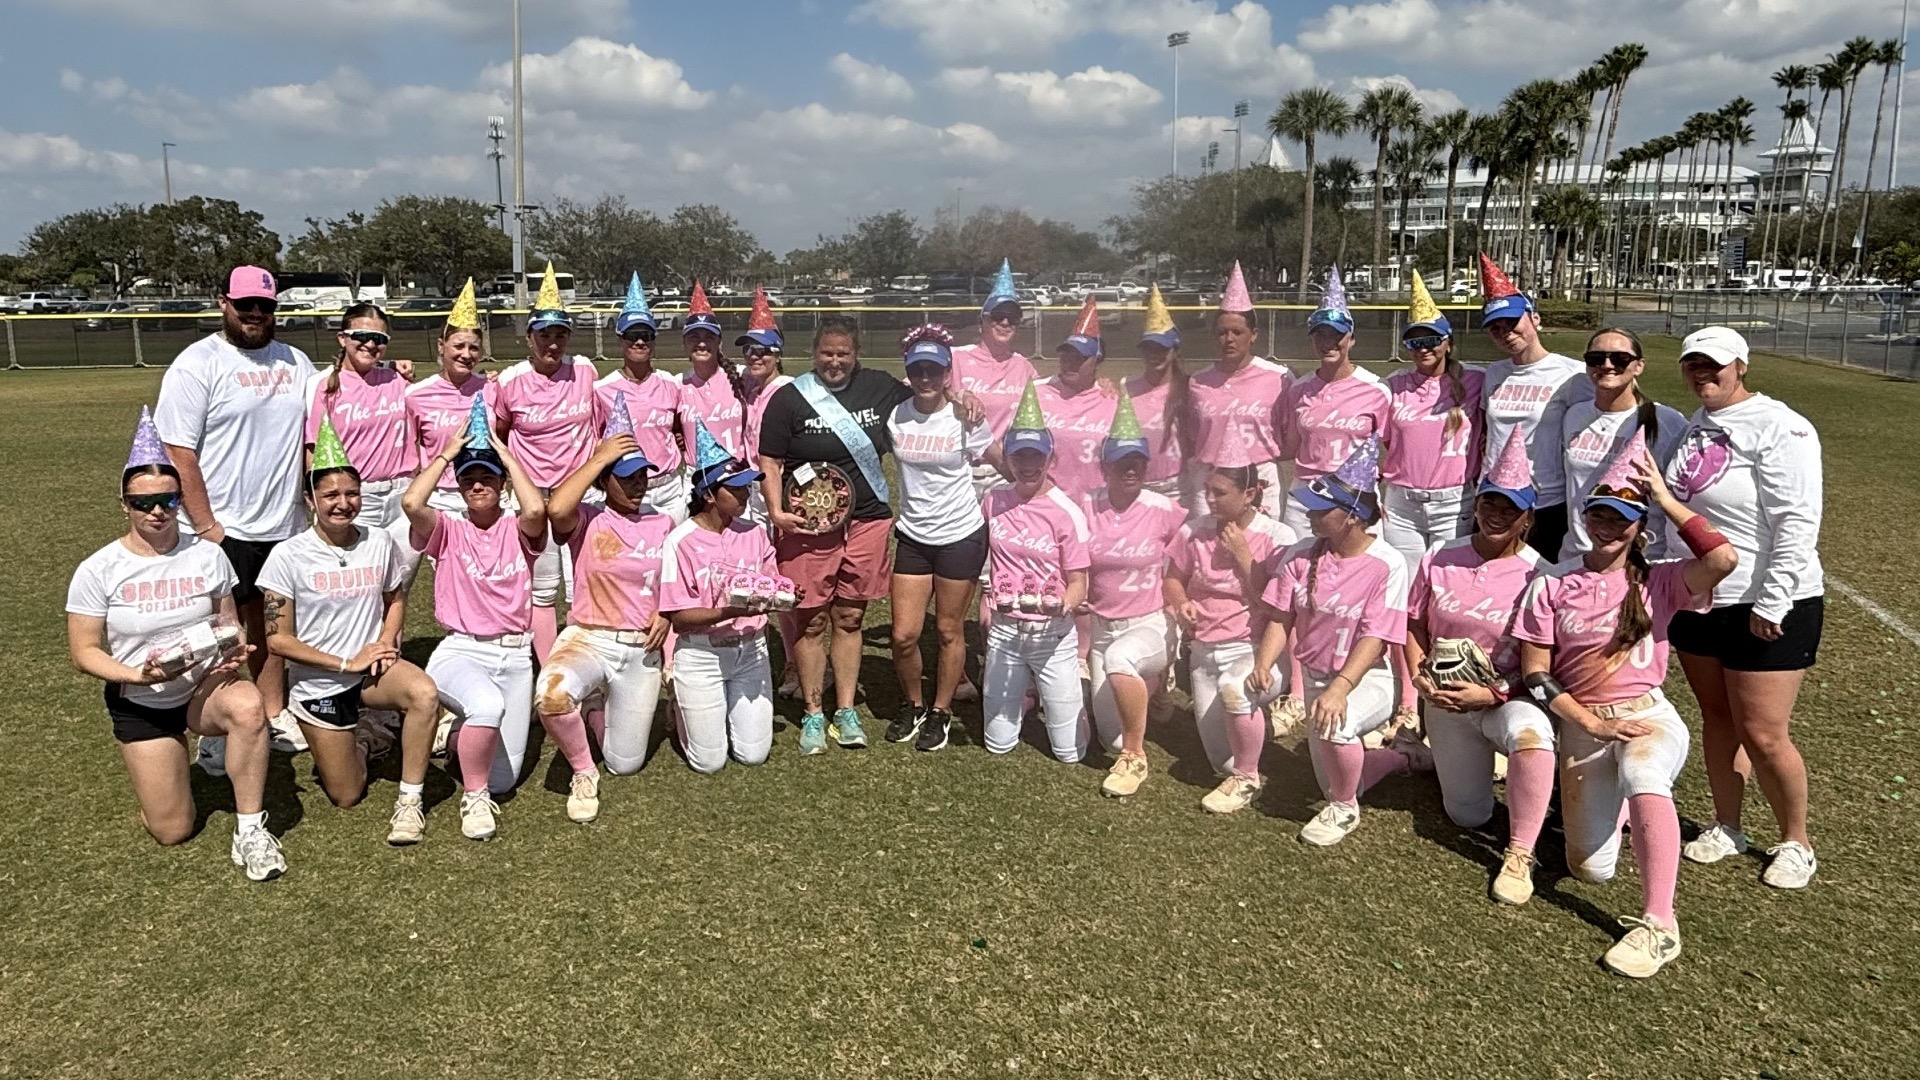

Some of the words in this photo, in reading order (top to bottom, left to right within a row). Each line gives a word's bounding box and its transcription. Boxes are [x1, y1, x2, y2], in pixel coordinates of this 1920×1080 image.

[961, 376, 990, 394] The
[991, 381, 1025, 395] Lak
[1490, 384, 1553, 402] BRUINS
[336, 402, 372, 425] The
[374, 395, 406, 416] Lak
[510, 404, 548, 423] The
[706, 402, 742, 422] Lak
[1220, 398, 1267, 417] Lake
[1392, 401, 1418, 422] The
[1494, 401, 1537, 412] SOFTBALL
[424, 409, 460, 431] The
[1317, 410, 1368, 431] Lake
[895, 432, 956, 452] BRUINS
[805, 490, 832, 509] 500
[990, 518, 1009, 540] The
[1008, 527, 1059, 554] Lake
[1104, 536, 1157, 558] Lake
[486, 549, 527, 582] Lak
[313, 564, 383, 592] BRUINS
[1119, 562, 1161, 592] 23
[121, 576, 206, 603] BRUINS
[1432, 584, 1461, 613] The
[1317, 592, 1365, 621] Lak
[1557, 607, 1585, 635] The
